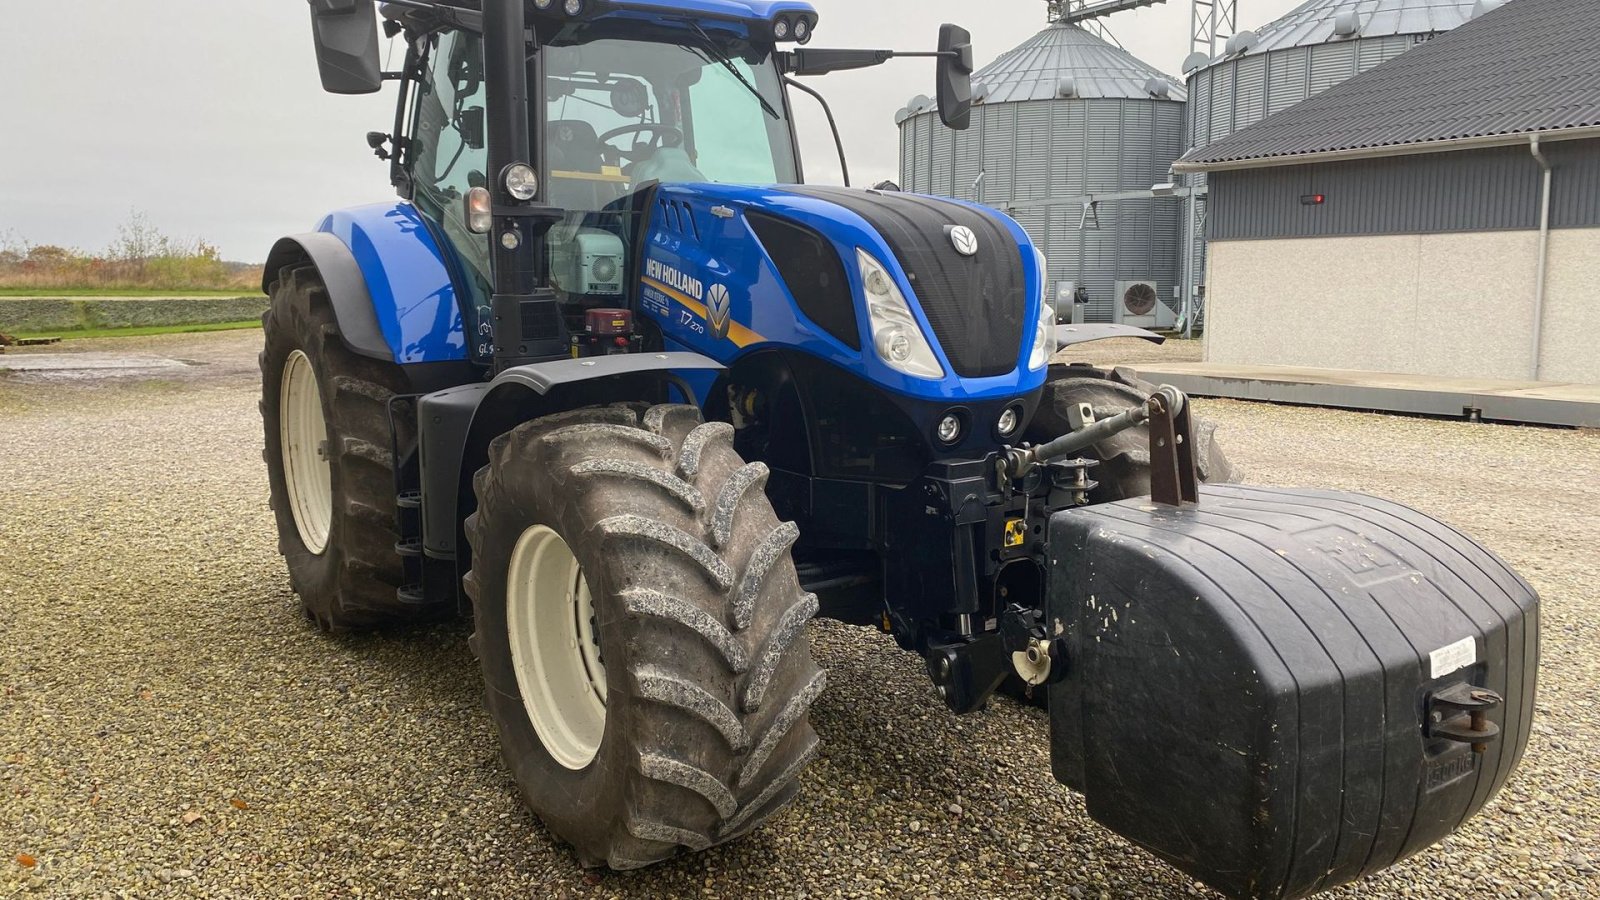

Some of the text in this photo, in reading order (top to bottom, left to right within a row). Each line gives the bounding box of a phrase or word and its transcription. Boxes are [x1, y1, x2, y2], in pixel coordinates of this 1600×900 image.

[646, 258, 662, 280] NEW
[663, 264, 703, 300] HOLLAND
[681, 310, 704, 334] T7 270
